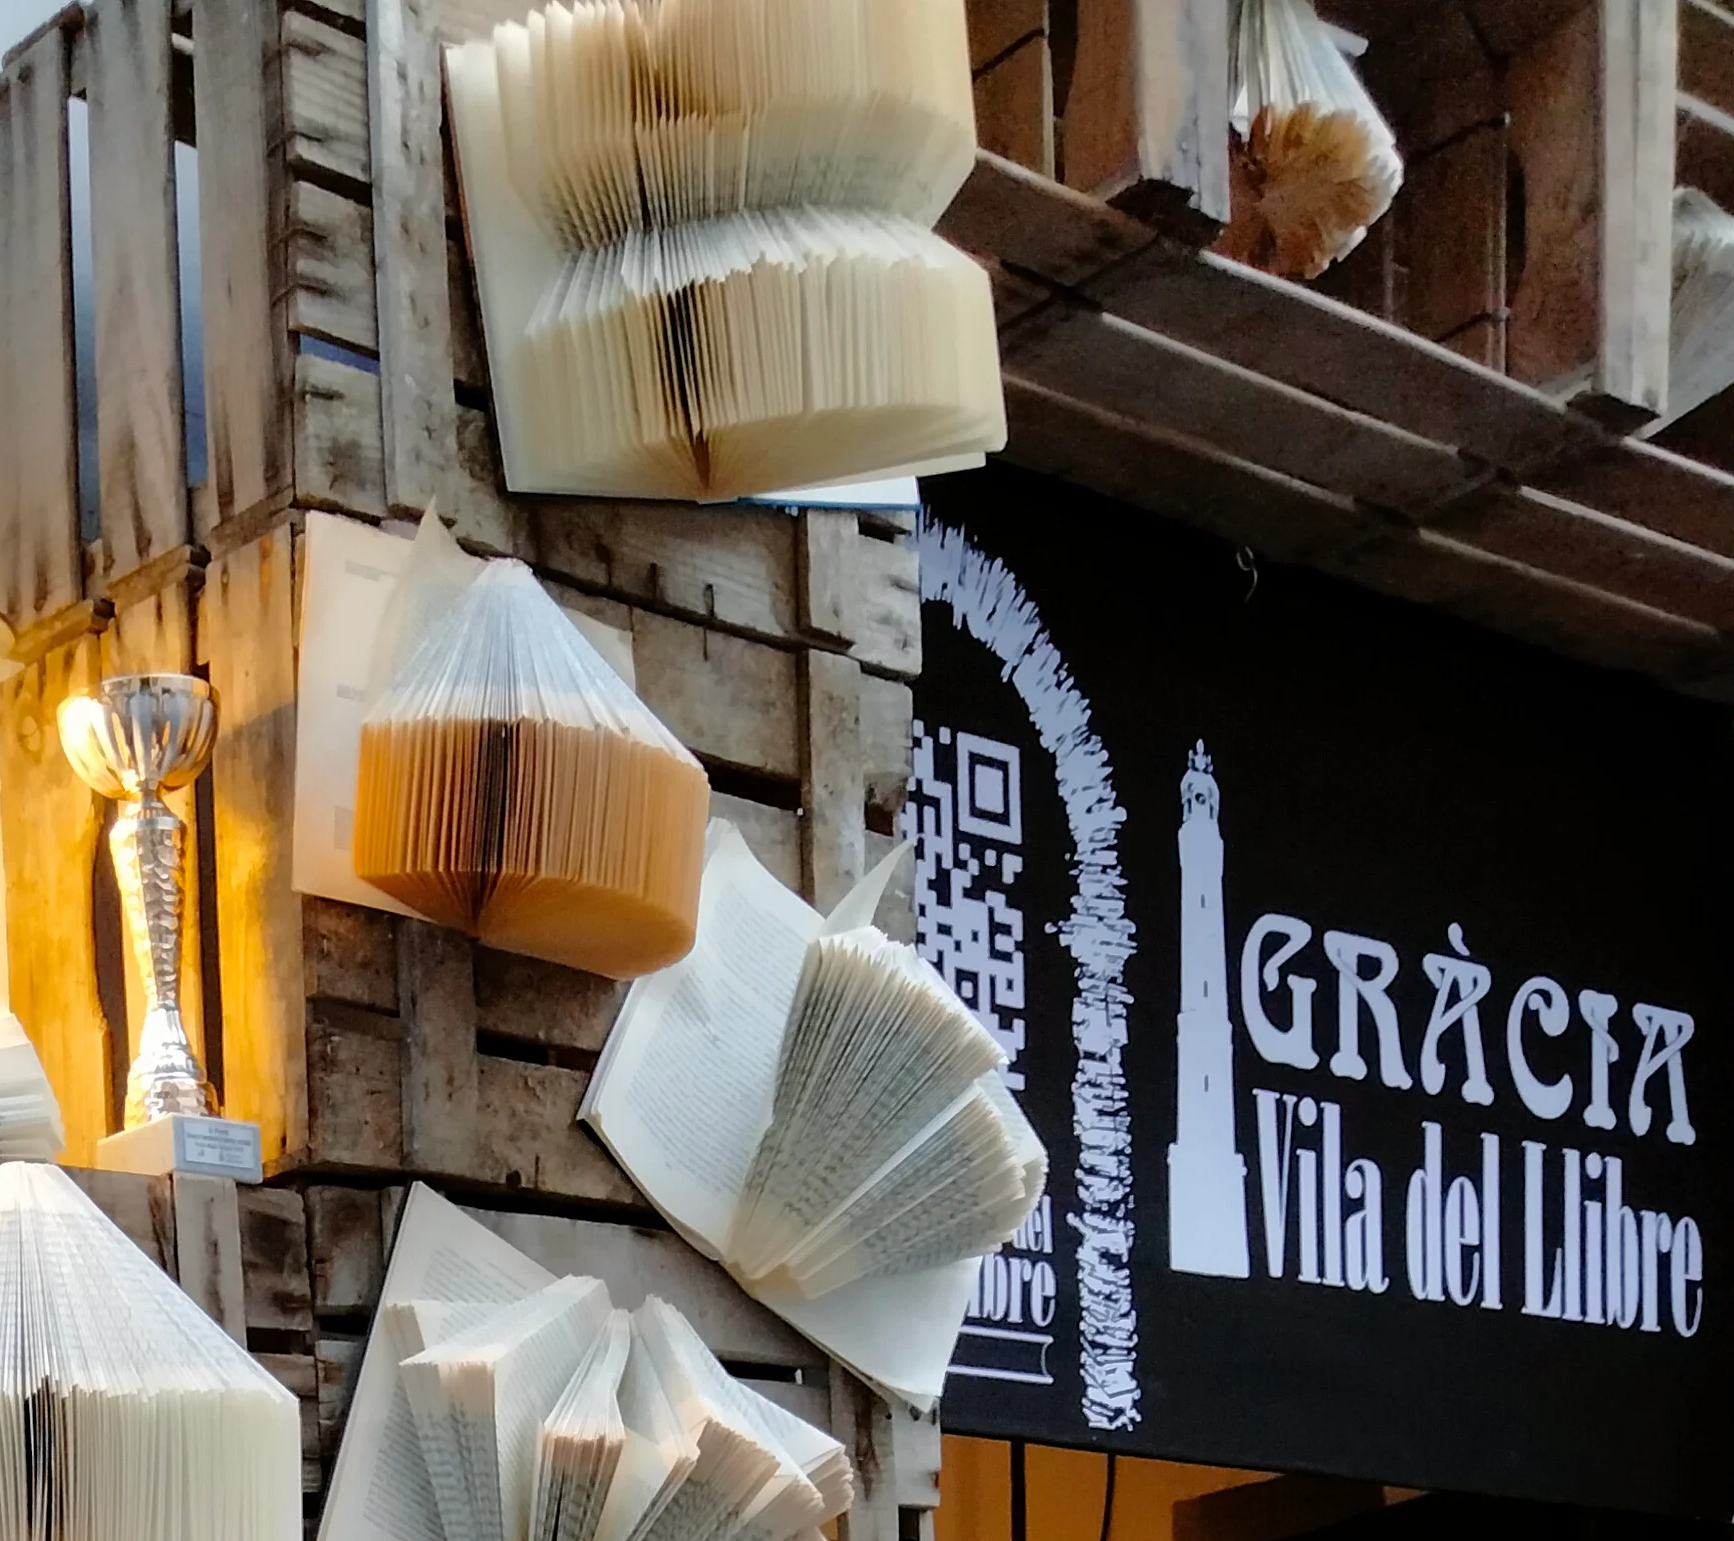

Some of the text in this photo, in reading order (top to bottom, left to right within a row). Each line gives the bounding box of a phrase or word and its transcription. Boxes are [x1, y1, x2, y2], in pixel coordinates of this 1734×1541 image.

[1241, 913, 1696, 1145] GRÀCIA
[1252, 1088, 1702, 1338] Vila del Llibre
